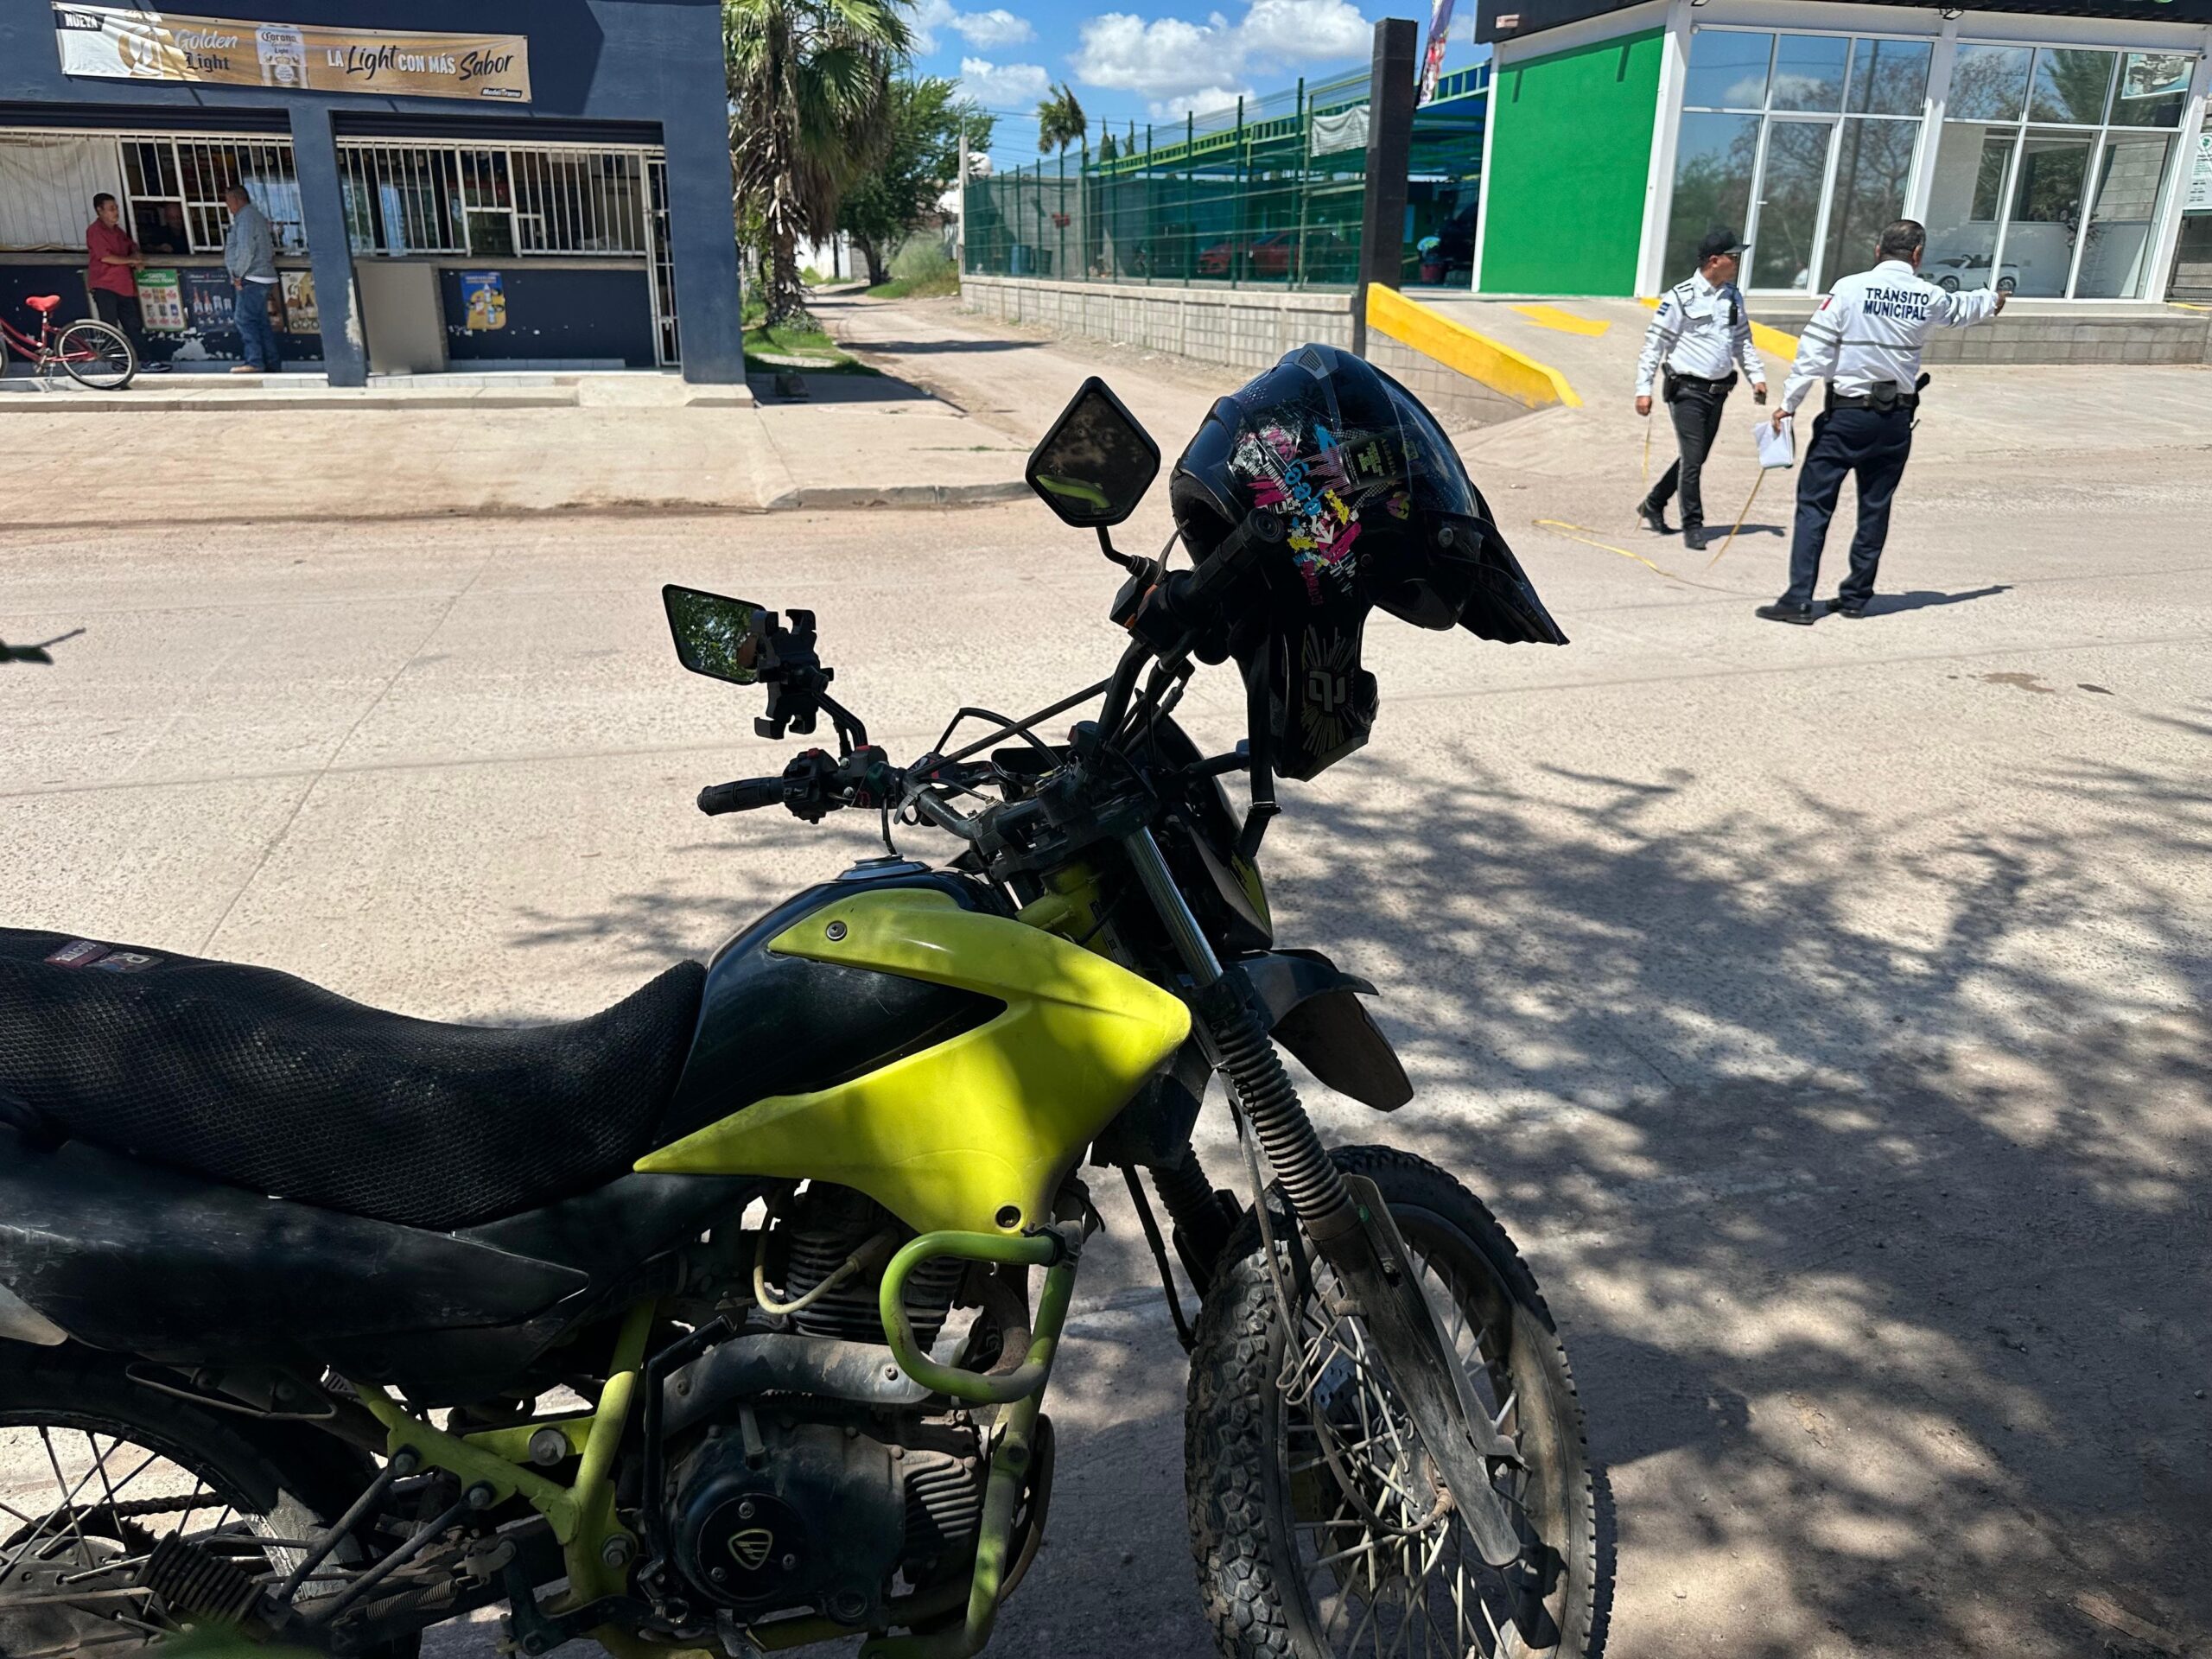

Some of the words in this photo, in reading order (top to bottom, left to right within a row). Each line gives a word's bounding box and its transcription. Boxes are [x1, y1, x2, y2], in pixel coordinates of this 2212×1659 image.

[65, 14, 98, 28] NUEVA
[175, 28, 238, 50] Golden
[262, 31, 297, 42] Corona
[186, 52, 231, 73] Light
[327, 49, 344, 67] LA
[346, 45, 400, 80] Light
[398, 54, 425, 73] CON
[429, 53, 456, 75] MÁS
[459, 50, 514, 81] Sabor
[1866, 287, 1929, 305] TRÁNSITO
[1863, 300, 1926, 321] MUNICIPAL
